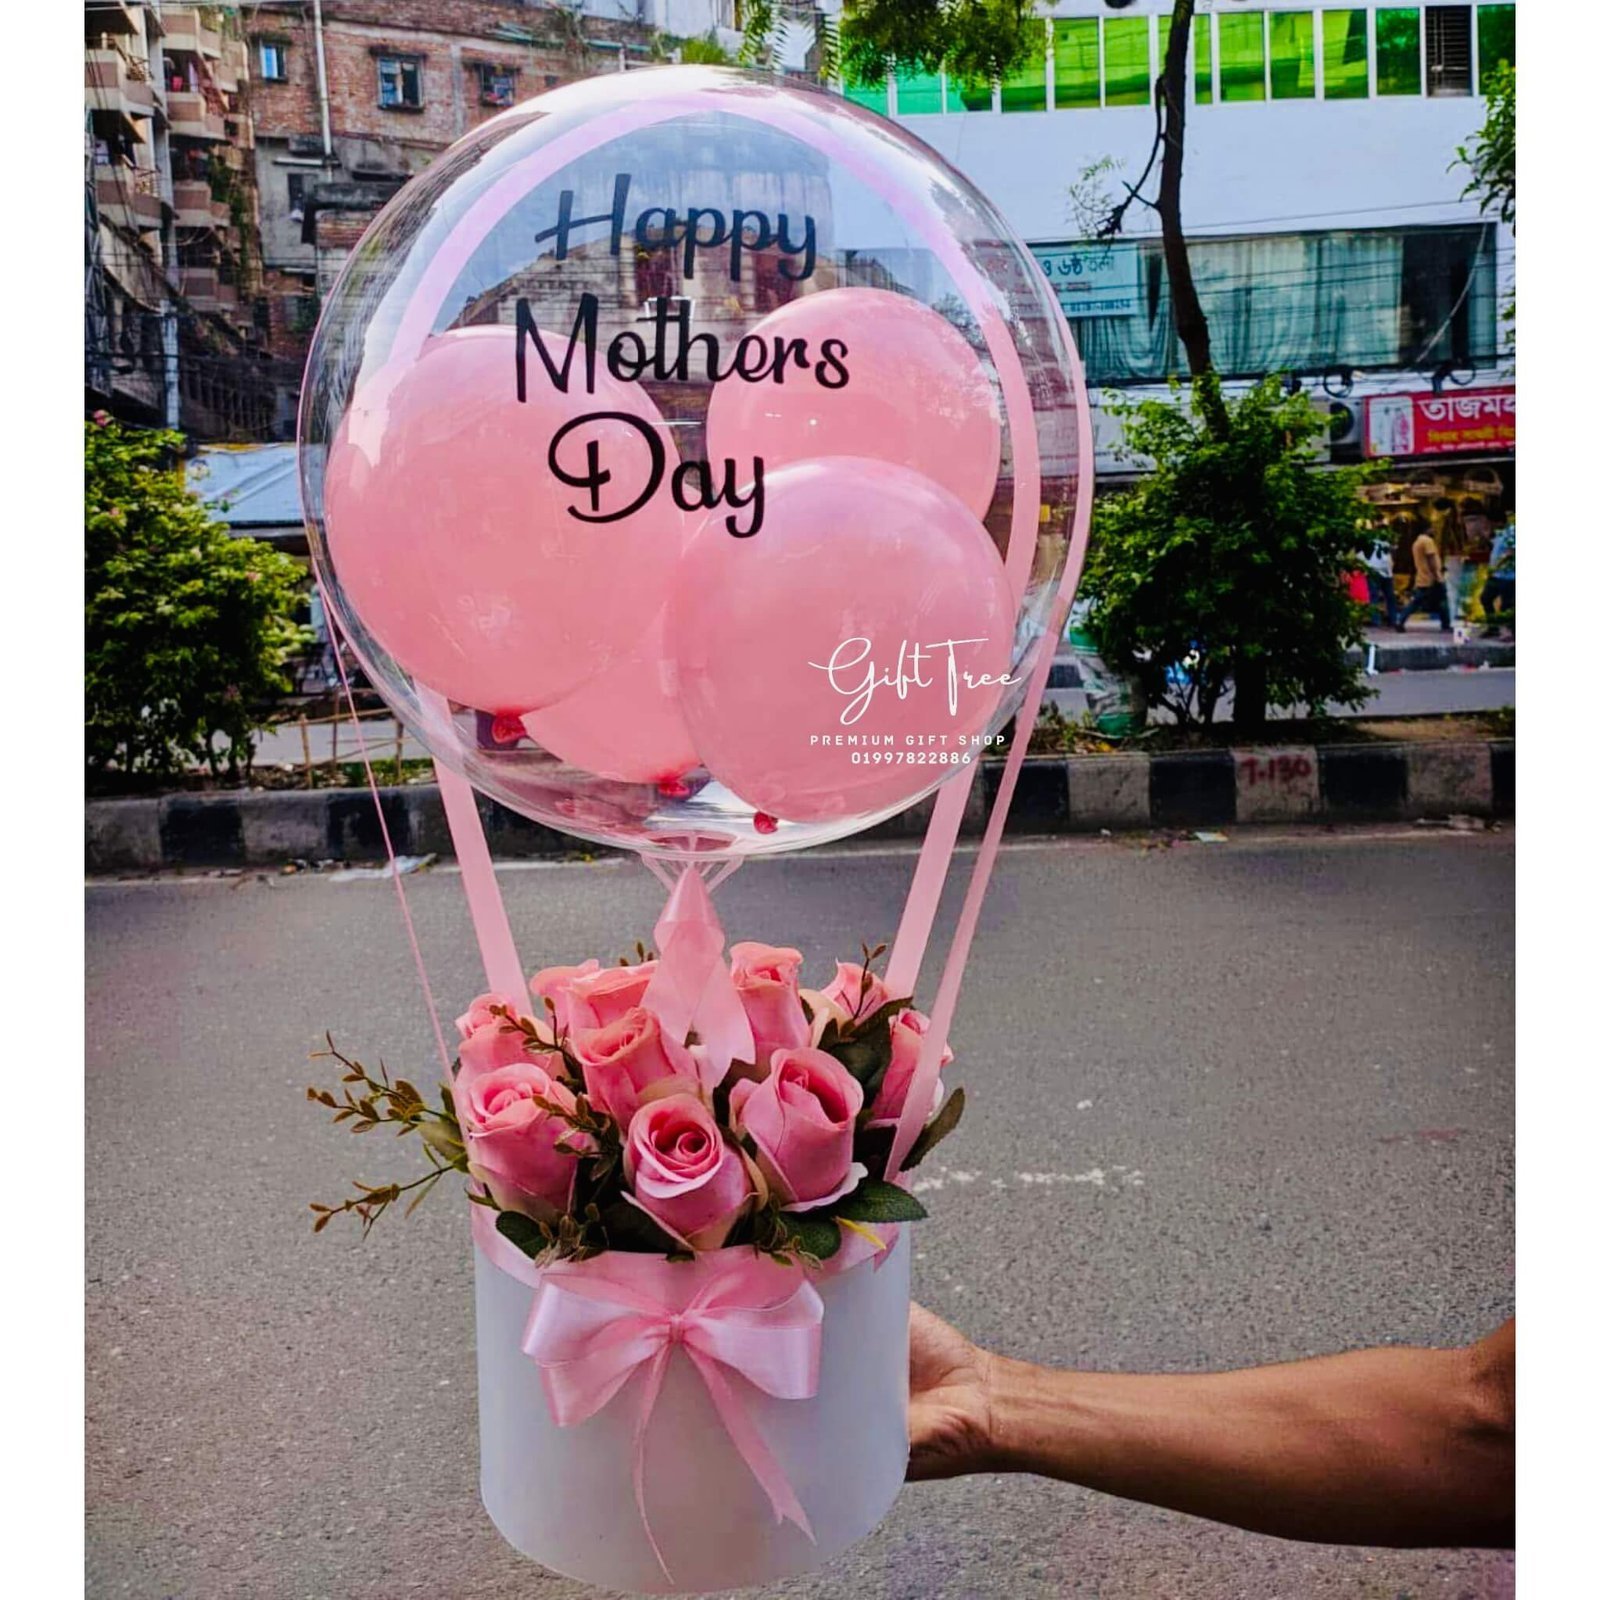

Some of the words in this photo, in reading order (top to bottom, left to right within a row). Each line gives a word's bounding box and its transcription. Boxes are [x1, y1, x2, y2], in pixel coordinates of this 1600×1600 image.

[534, 173, 818, 282] Happy
[515, 292, 850, 404] Mothers
[547, 411, 765, 539] Day
